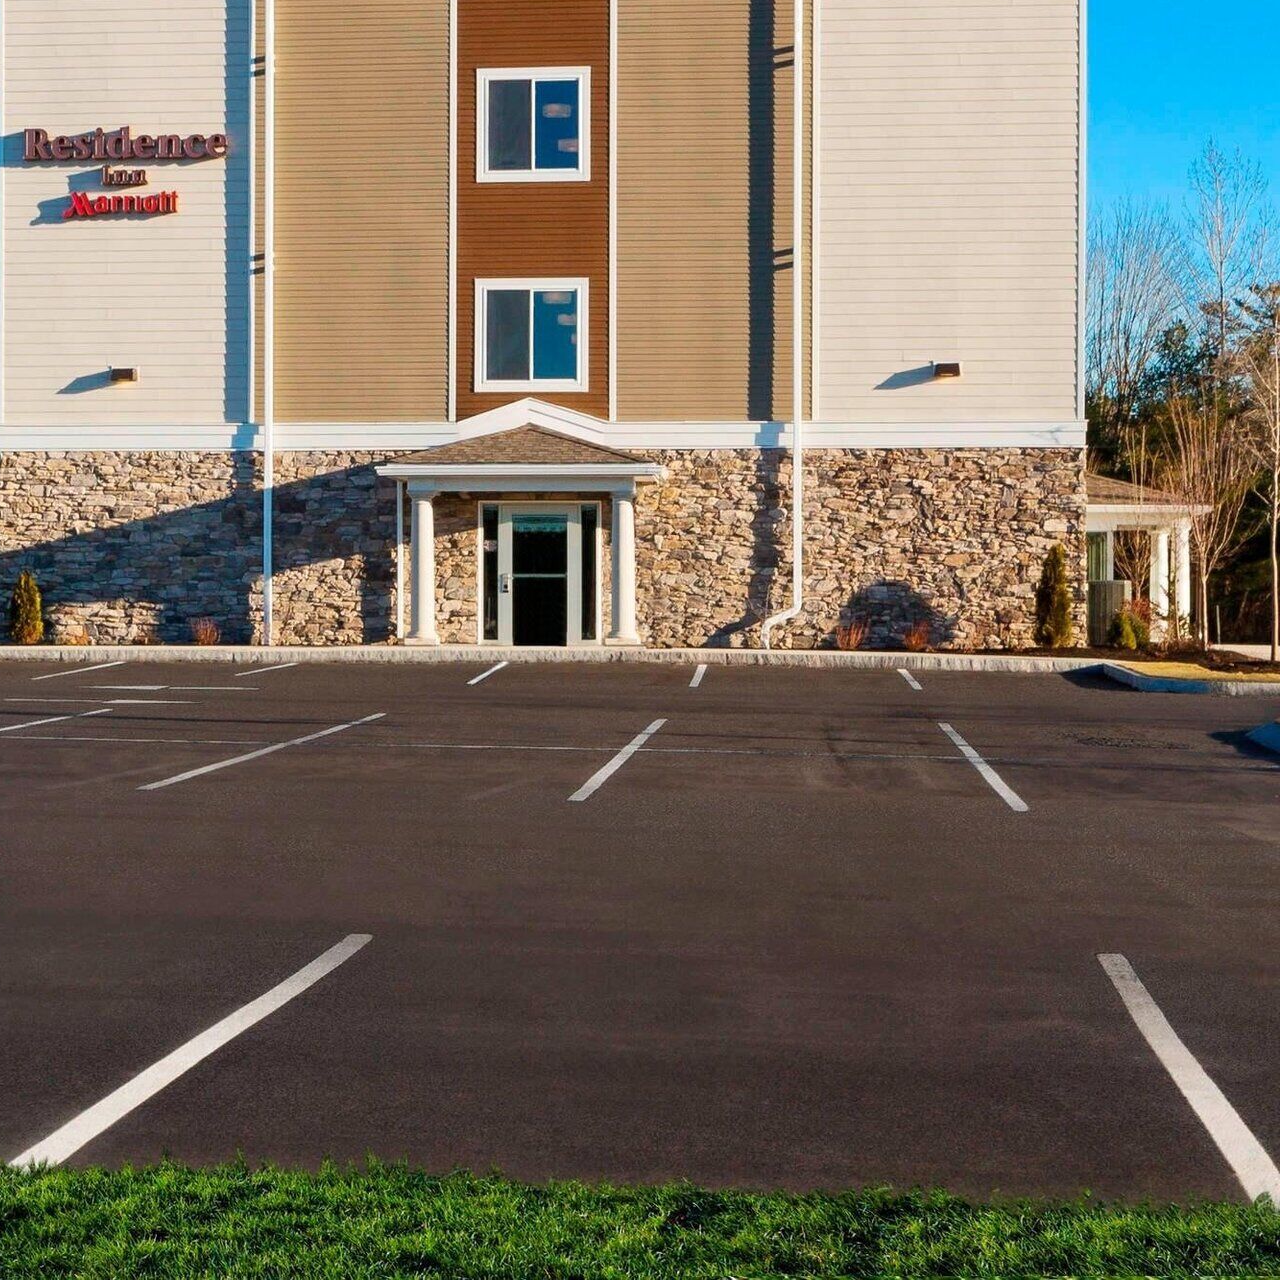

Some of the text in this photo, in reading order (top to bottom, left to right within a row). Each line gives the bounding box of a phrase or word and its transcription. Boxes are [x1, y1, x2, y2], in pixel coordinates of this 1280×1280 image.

[23, 126, 228, 160] Residence
[101, 164, 149, 186] Inn
[63, 191, 178, 218] Marriott
